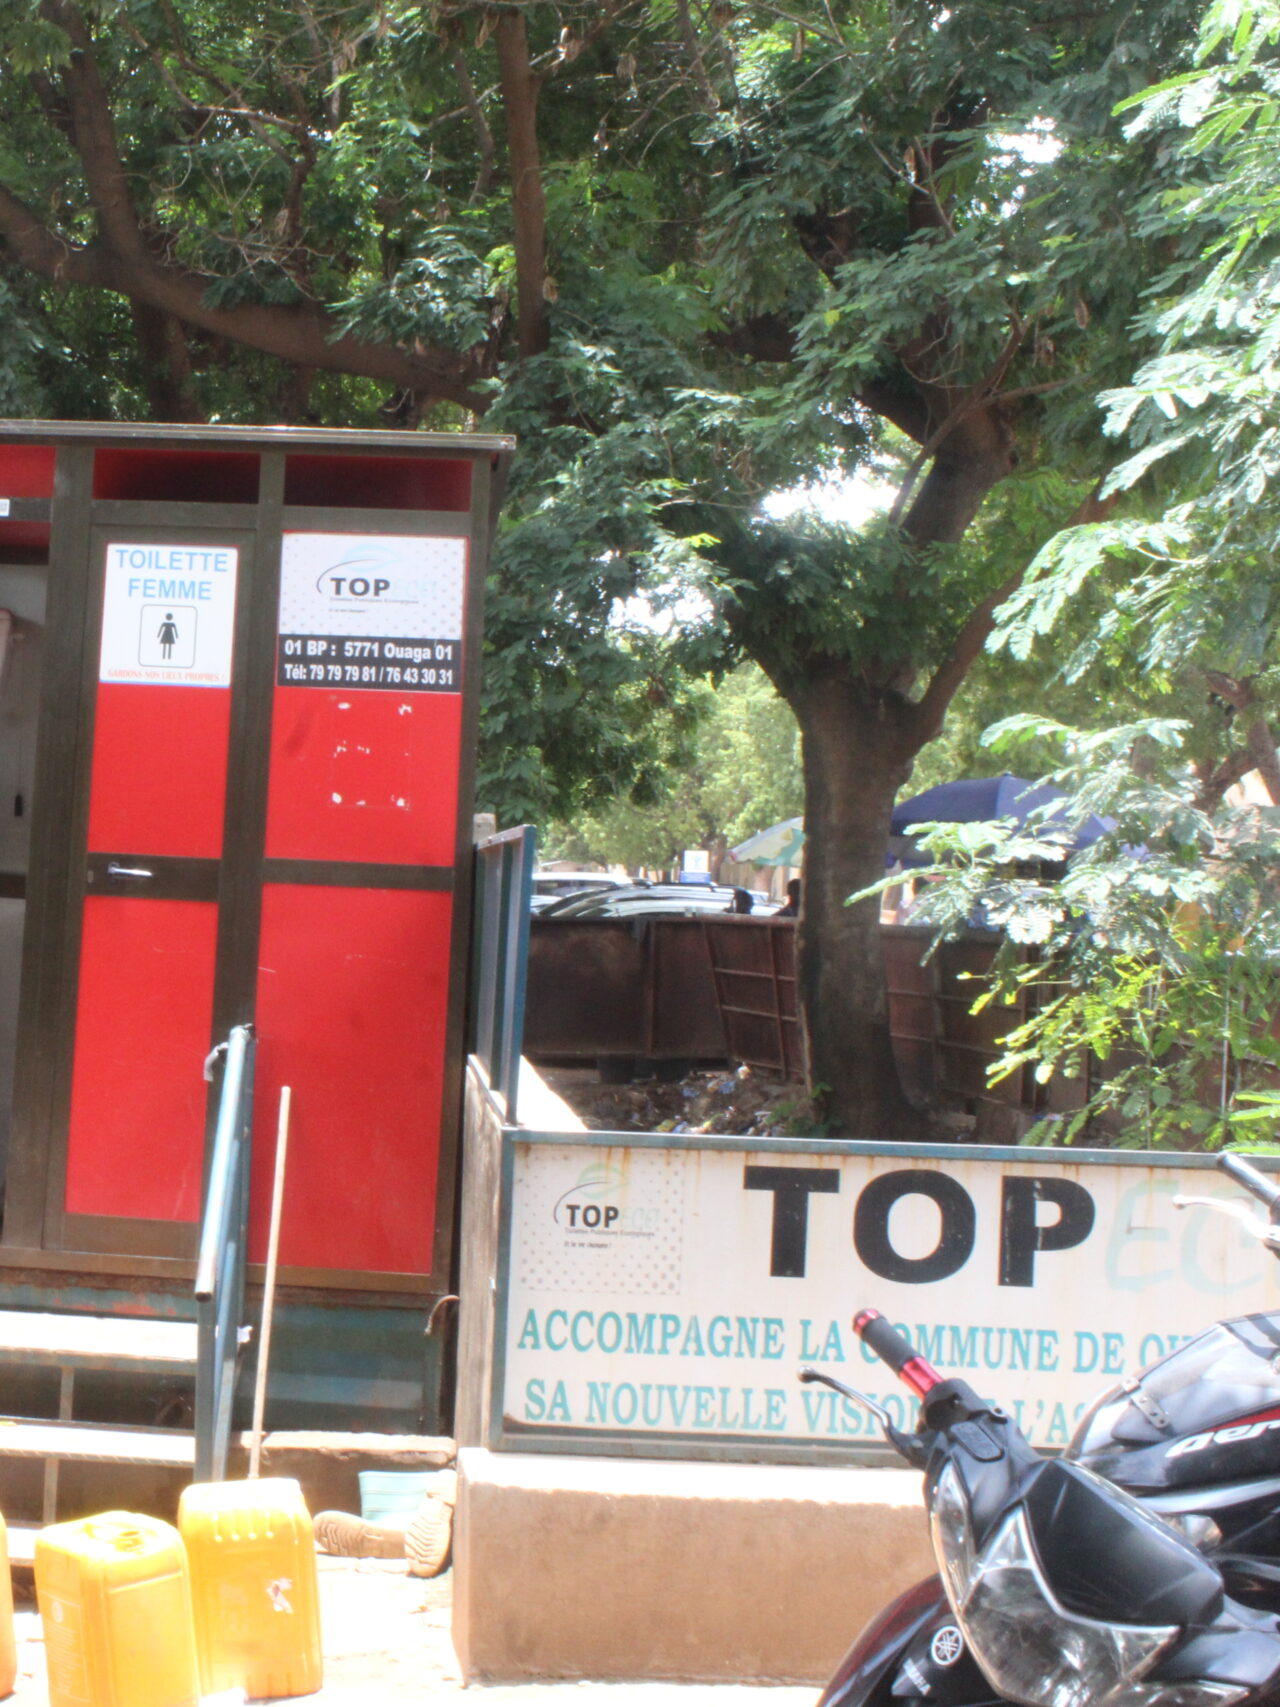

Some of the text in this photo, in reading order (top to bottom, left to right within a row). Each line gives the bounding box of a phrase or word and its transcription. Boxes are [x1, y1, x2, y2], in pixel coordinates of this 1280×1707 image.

[115, 548, 228, 573] TOILETTE
[128, 578, 212, 600] FEMME
[284, 639, 302, 655] 01
[307, 640, 327, 656] BP
[344, 641, 379, 657] 5771
[384, 643, 431, 663] Ouaga
[435, 645, 453, 661] 01
[284, 664, 307, 679] Tél:
[310, 664, 324, 680] 79
[327, 665, 341, 681] 79
[344, 665, 359, 681] 79
[362, 666, 376, 682] 81
[386, 667, 401, 683] 76
[403, 667, 418, 683] 43
[421, 668, 436, 684] 30
[439, 669, 453, 685] 31
[517, 1308, 785, 1360] ACCOMPAGNE
[798, 1319, 845, 1363] LA
[1073, 1331, 1125, 1375] DE
[524, 1378, 572, 1422] SA
[585, 1381, 788, 1432] NOUVELLE
